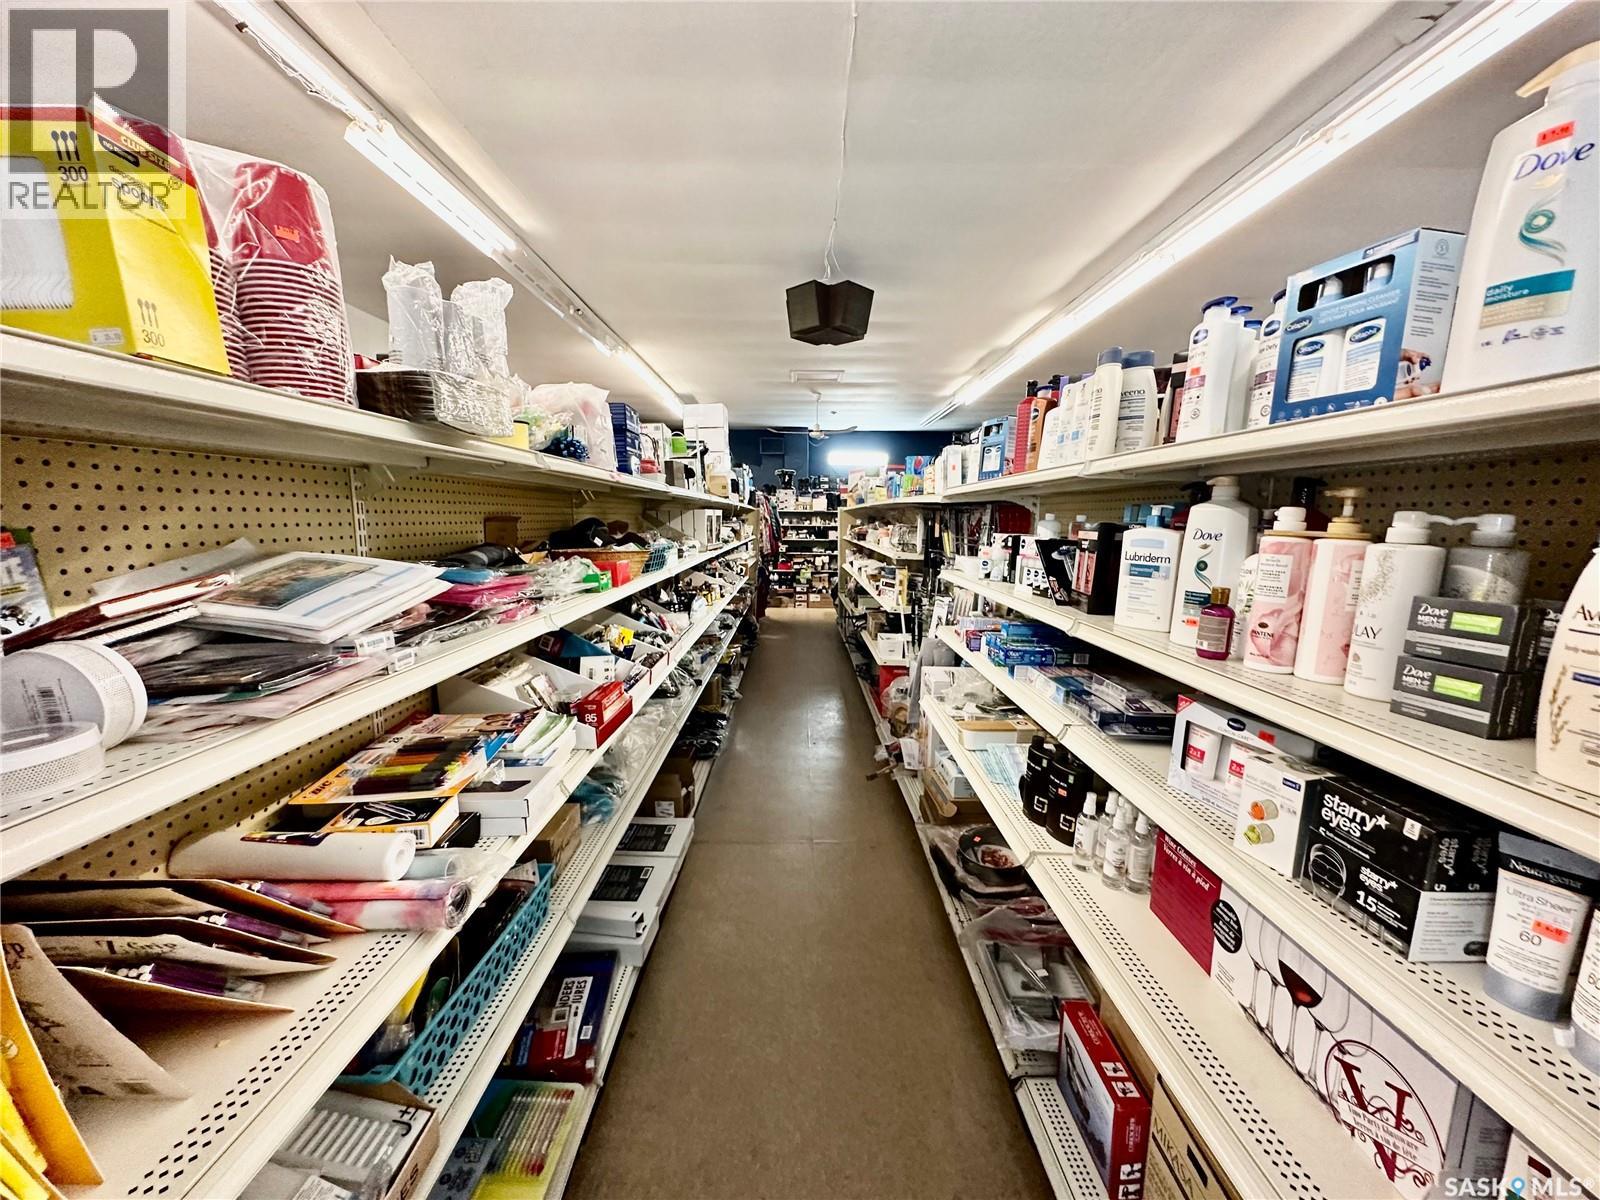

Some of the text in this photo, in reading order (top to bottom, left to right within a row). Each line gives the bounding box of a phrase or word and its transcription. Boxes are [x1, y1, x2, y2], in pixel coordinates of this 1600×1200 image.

[1514, 142, 1595, 181] Dove
[58, 165, 89, 182] 300
[1486, 283, 1515, 297] daily
[142, 328, 166, 347] 300
[1192, 528, 1224, 542] Dove
[1124, 551, 1171, 565] Lubriderm
[1418, 602, 1449, 617] Dove
[1403, 663, 1432, 679] Dove
[585, 713, 597, 723] 85
[310, 779, 332, 795] BIC
[1322, 793, 1379, 833] starry
[1321, 806, 1362, 838] eyes
[1437, 837, 1451, 864] eyes
[1360, 866, 1392, 891] starry
[1509, 858, 1583, 889] Neutrogena
[1195, 875, 1211, 892] pied
[1359, 873, 1384, 893] eyes
[1434, 883, 1447, 892] 5
[1356, 890, 1378, 914] 15
[1505, 886, 1534, 903] Ultra
[1519, 930, 1542, 946] 60
